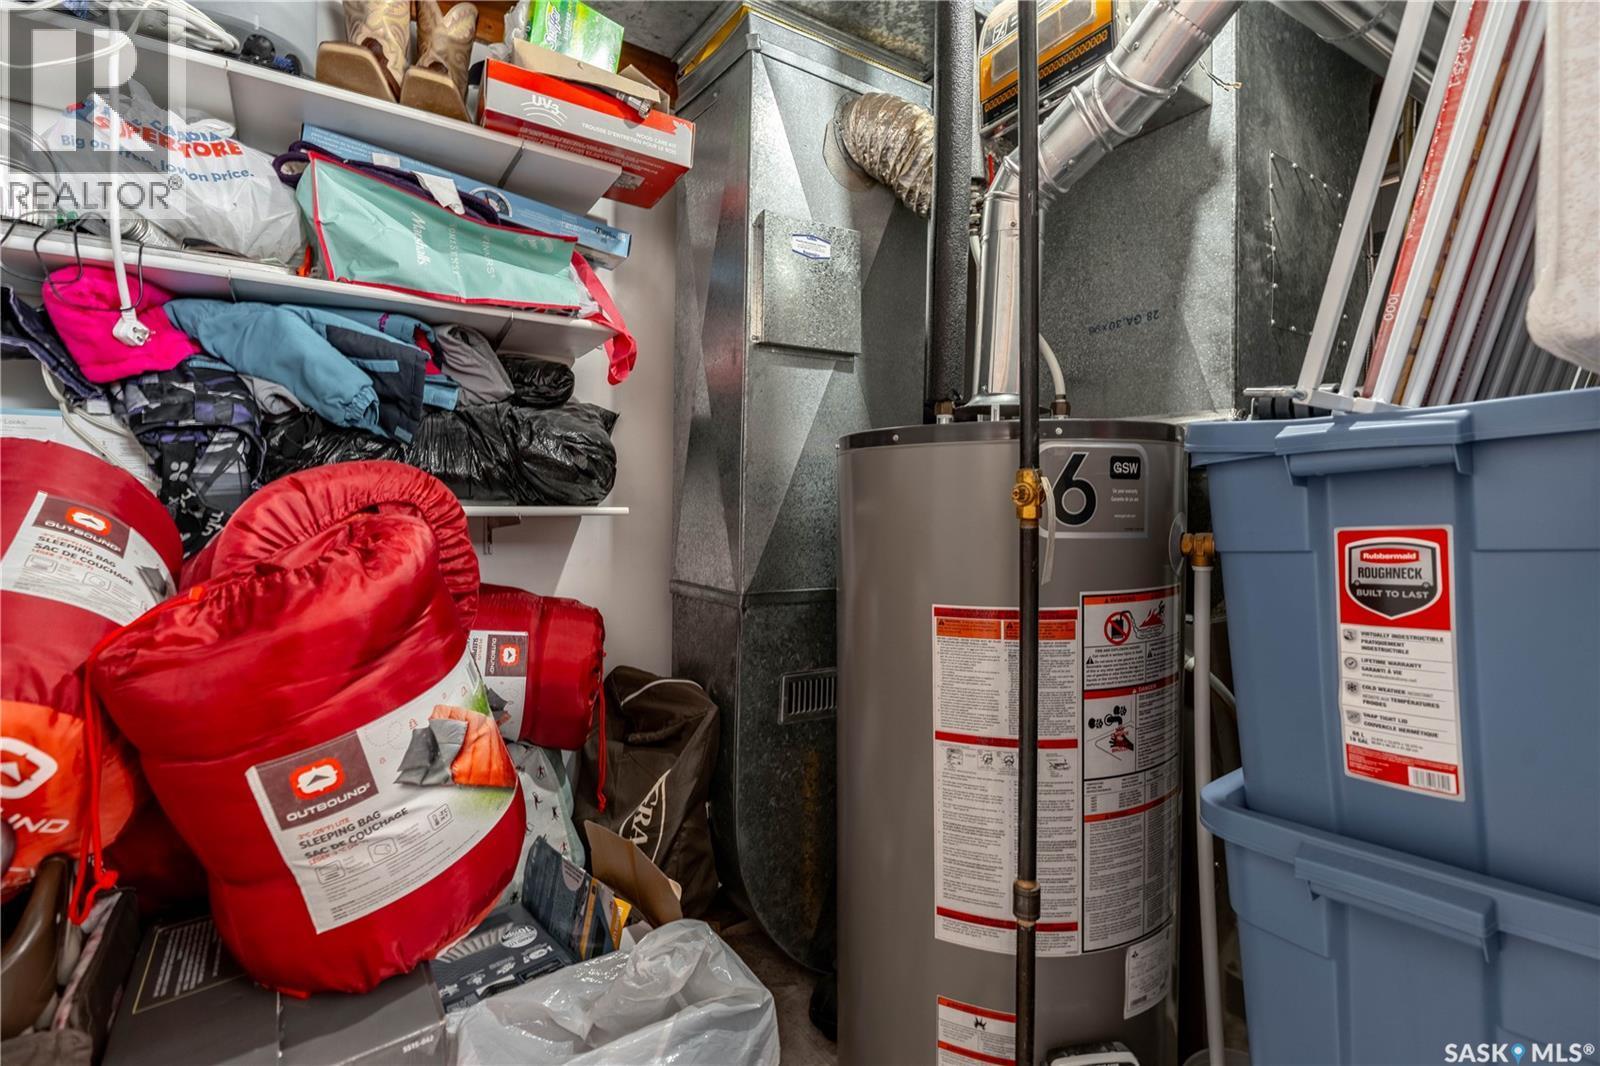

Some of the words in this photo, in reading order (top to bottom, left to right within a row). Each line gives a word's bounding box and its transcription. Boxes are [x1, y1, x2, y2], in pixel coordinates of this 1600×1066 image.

[94, 114, 243, 158] SUPERTORE
[61, 134, 85, 148] Big
[90, 139, 110, 150] on
[188, 172, 209, 183] on
[212, 169, 254, 183] price.
[1113, 462, 1138, 474] GSW
[1053, 452, 1098, 528] 6
[34, 542, 59, 554] SAC
[62, 550, 78, 560] DE
[80, 556, 134, 586] COUCHAGE
[38, 536, 93, 557] SLEEPING
[96, 554, 116, 568] BAG
[1362, 552, 1417, 560] Rubbermaid
[1358, 566, 1422, 580] ROUGHNECK
[1356, 589, 1382, 597] BUILT
[1402, 591, 1430, 599] LAST
[1392, 634, 1444, 642] INDESTRUCTIBLE
[1378, 686, 1406, 694] WEATHER
[286, 784, 368, 822] OUTBOUND
[298, 821, 356, 850] SLEEPING
[358, 810, 382, 828] BAG
[304, 846, 329, 859] SAC
[330, 840, 346, 850] DE
[348, 807, 409, 844] COUCHAGE
